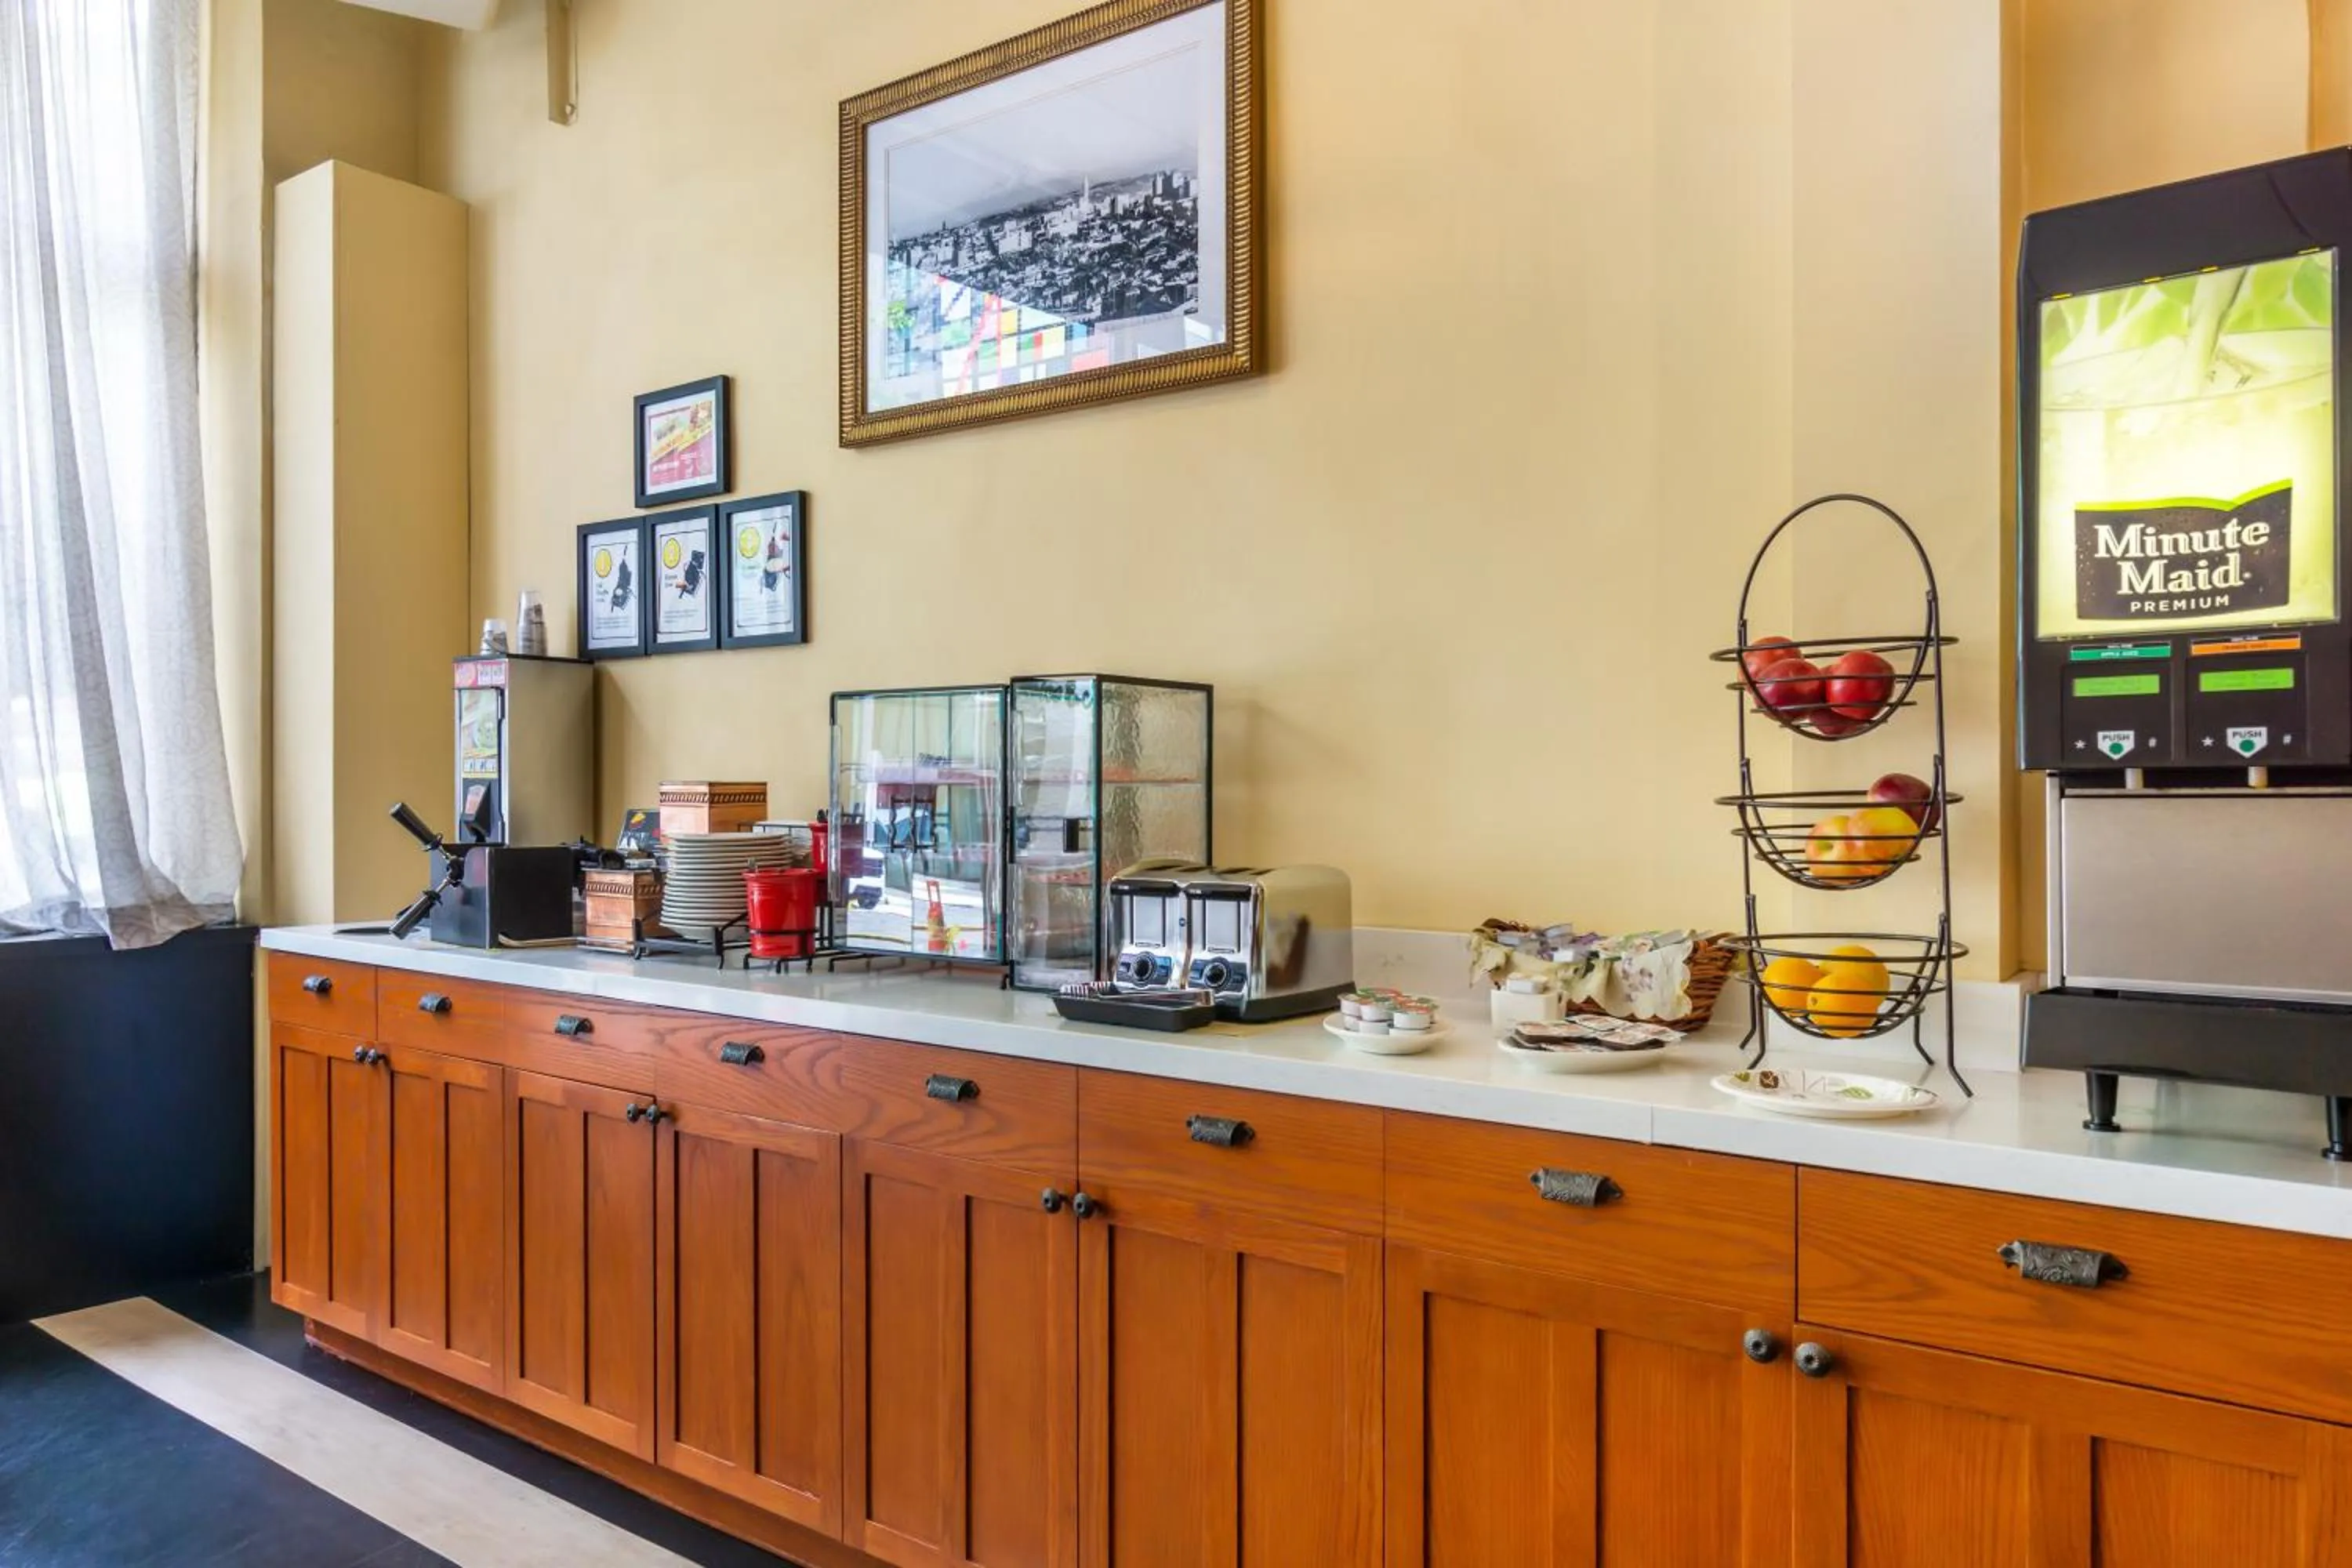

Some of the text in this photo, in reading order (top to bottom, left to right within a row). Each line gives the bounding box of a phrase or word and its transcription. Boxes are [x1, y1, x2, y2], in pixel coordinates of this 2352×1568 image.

[2092, 517, 2270, 557] Minute
[2117, 551, 2245, 595] Maid
[2130, 594, 2230, 612] PREMIUM
[2232, 730, 2262, 739] PUSH
